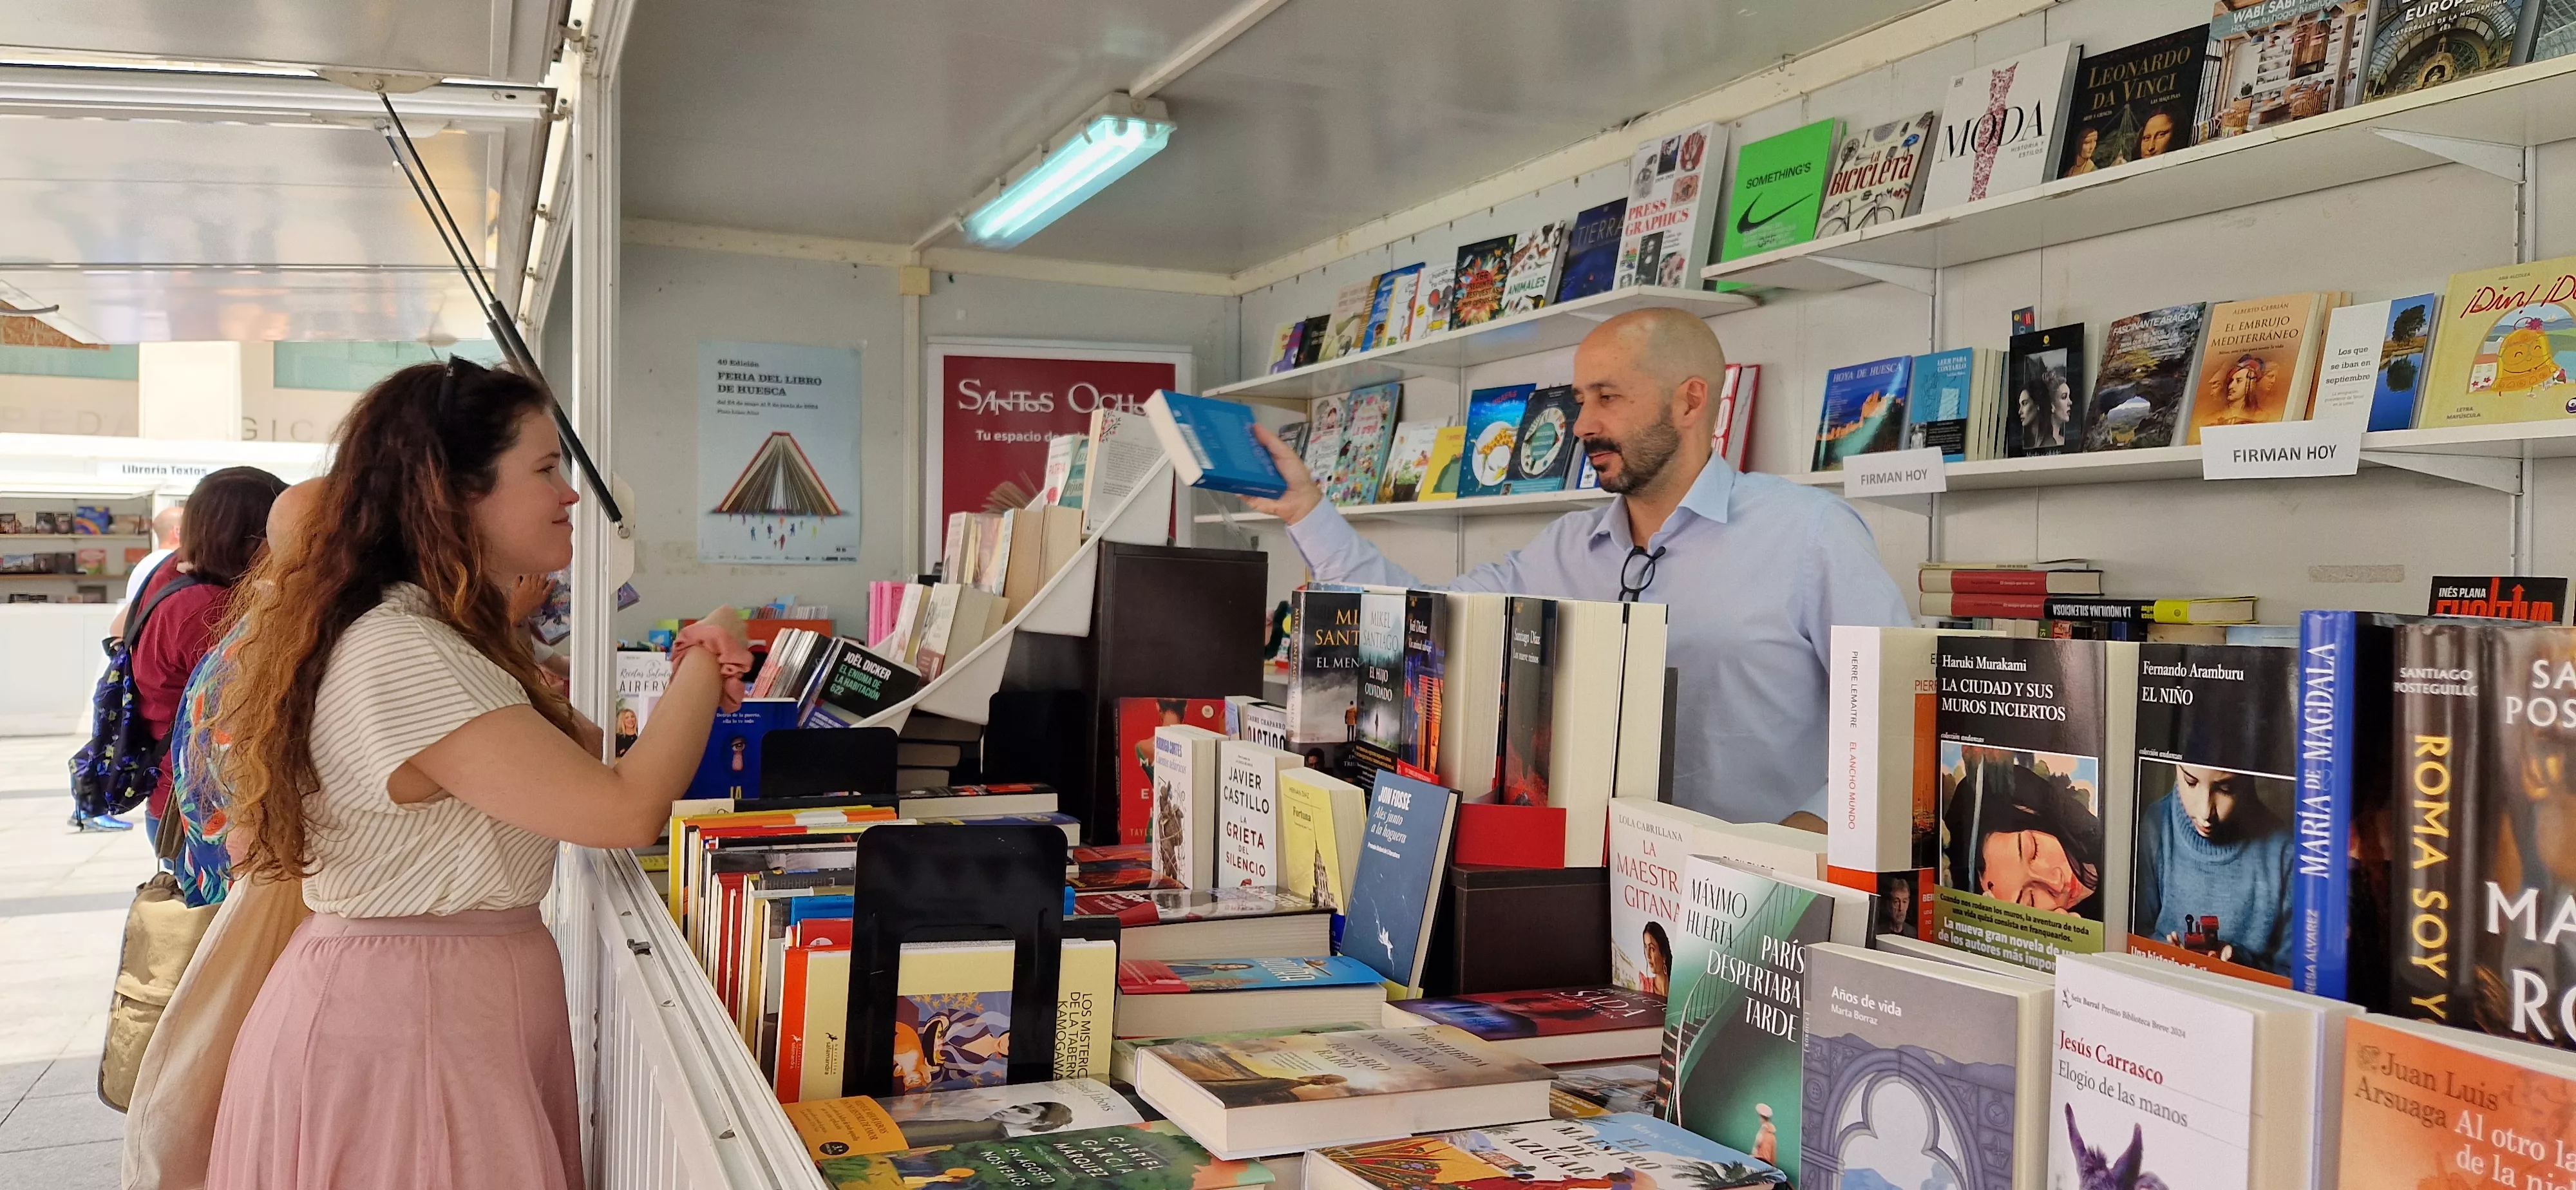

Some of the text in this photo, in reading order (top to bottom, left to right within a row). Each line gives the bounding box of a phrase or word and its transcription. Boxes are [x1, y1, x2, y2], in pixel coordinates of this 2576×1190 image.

[2233, 6, 2264, 24] WABI
[2391, 20, 2435, 37] CATEDRALES
[2087, 46, 2191, 90] LEONARDO
[2092, 72, 2176, 111] DA VINCI
[1938, 99, 2045, 164] MODA
[2011, 142, 2038, 153] HISTORIA
[2018, 148, 2043, 158] ESTILOS
[1746, 162, 1812, 190] SOMETHING'S
[1628, 198, 1667, 220] PRESS
[1577, 216, 1625, 247] TIERRA
[1625, 207, 1689, 237] GRAPHICS
[1507, 276, 1547, 296] ANIMALES
[2540, 274, 2576, 308] ¡D
[2233, 303, 2289, 315] ALBERTO CEBRIÁN
[2112, 310, 2199, 336] FASCINANTE ARAGÓN
[2225, 316, 2290, 332] EL EMBRUJO
[2211, 328, 2299, 347] MEDITERRÁNEO
[1952, 355, 1967, 364] PARA
[2353, 346, 2369, 355] que
[717, 372, 822, 386] FERIA DEL LIBRO
[1833, 362, 1902, 383] HOYA DE HUESCA
[1937, 363, 1967, 373] CONTARLO
[2325, 373, 2371, 385] septiembre
[717, 384, 787, 396] DE HUESCA
[1068, 382, 1146, 417] OCHO
[976, 430, 1041, 443] Tu espacio
[2233, 444, 2337, 464] FIRMAN HOY
[1860, 469, 1928, 486] FIRMAN HOY
[2439, 586, 2486, 598] INÉS PLANA
[1371, 610, 1391, 629] MIKEL
[2052, 604, 2088, 617] SILENCIOSA
[2090, 605, 2122, 618] INQUILINA
[2123, 605, 2131, 618] LA
[1416, 620, 1428, 634] Dicker
[1363, 629, 1399, 652] SANTIAGO
[843, 651, 891, 681] JOËL DICKER
[1369, 666, 1388, 684] EL HIJO
[1942, 654, 2027, 673] Haruki Murakami
[2143, 661, 2244, 681] Fernando Aramburu
[2400, 667, 2474, 681] SANTIAGO
[620, 680, 668, 693] AIRFRY
[835, 675, 881, 701] LA HABITACIÓN
[839, 664, 882, 690] EL ENIGMA DE
[1941, 677, 2054, 699] LA CIUDAD Y SUS
[829, 685, 844, 696] 622
[1365, 683, 1393, 702] OLVIDADO
[2141, 684, 2193, 706] EL NIÑO
[1850, 684, 1858, 729] LEMAITRE
[1941, 697, 2066, 722] MUROS INCIERTOS
[1850, 742, 1857, 752] EL
[1848, 754, 1857, 790] ANCHO
[2297, 643, 2335, 879] MARÍA DE MAGDALA
[1229, 766, 1262, 791] JAVIER
[1224, 787, 1270, 815] CASTILLO
[1378, 785, 1412, 811] JON FOSSE
[1848, 792, 1856, 829] MUNDO
[1240, 815, 1247, 824] LA
[1293, 806, 1311, 822] Fortuna
[1374, 805, 1404, 827] Ales junto
[1226, 821, 1265, 850] GRIETA
[1370, 824, 1407, 844] a la hoguera
[1618, 814, 1683, 842] LOLA CABRILLANA
[1238, 844, 1249, 855] DEL
[1642, 839, 1657, 858] LA
[1226, 851, 1266, 878] SILENCIO
[1616, 851, 1682, 895] MAESTR
[2410, 734, 2452, 1021] ROMA SOY Y
[1690, 877, 1747, 919] MÁXIMO
[1686, 909, 1733, 949] HUERTA
[1944, 916, 1954, 929] La
[1955, 922, 1984, 938] nueva
[1985, 930, 2008, 945] gran
[2009, 936, 2044, 953] novela
[2046, 944, 2061, 956] de
[1761, 934, 1806, 974] PARÍS
[1707, 948, 1801, 1009] DESPERTABA
[1831, 985, 1902, 1017] Años de vida
[1745, 996, 1799, 1044] TARDE
[1831, 1003, 1879, 1026] Marta Borraz
[2070, 994, 2186, 1039] Seix Barral Premio Biblioteca Breve 2024
[1053, 1000, 1068, 1081] KAMOGAWA
[1065, 992, 1081, 1080] DE LA TABERN
[1077, 993, 1093, 1079] LOS MISTERIO
[1312, 1049, 1358, 1069] RARO
[1326, 1042, 1392, 1072] ROSARIO
[1408, 1032, 1490, 1068] PROHIBIDA
[1412, 1046, 1443, 1057] EN
[2060, 1030, 2164, 1086] Jesús Carrasco
[2058, 1059, 2188, 1128] Elogio de las manos
[2381, 1052, 2499, 1111] Juan Luis
[2354, 1075, 2448, 1129] Arsuaga
[1551, 1126, 1662, 1170] MAESTRO
[1556, 1144, 1599, 1159] DE
[1616, 1138, 1653, 1150] EL
[2454, 1109, 2576, 1171] Al otro la
[1005, 1148, 1022, 1157] EN
[1016, 1159, 1056, 1184] AGOSTO
[1053, 1142, 1110, 1178] MÁRQUEZ
[1081, 1140, 1137, 1175] GARCÍA
[1107, 1137, 1164, 1171] GABRIEL
[1502, 1138, 1596, 1175] AZÚCAR
[980, 1151, 1031, 1187] NOS VEMOS
